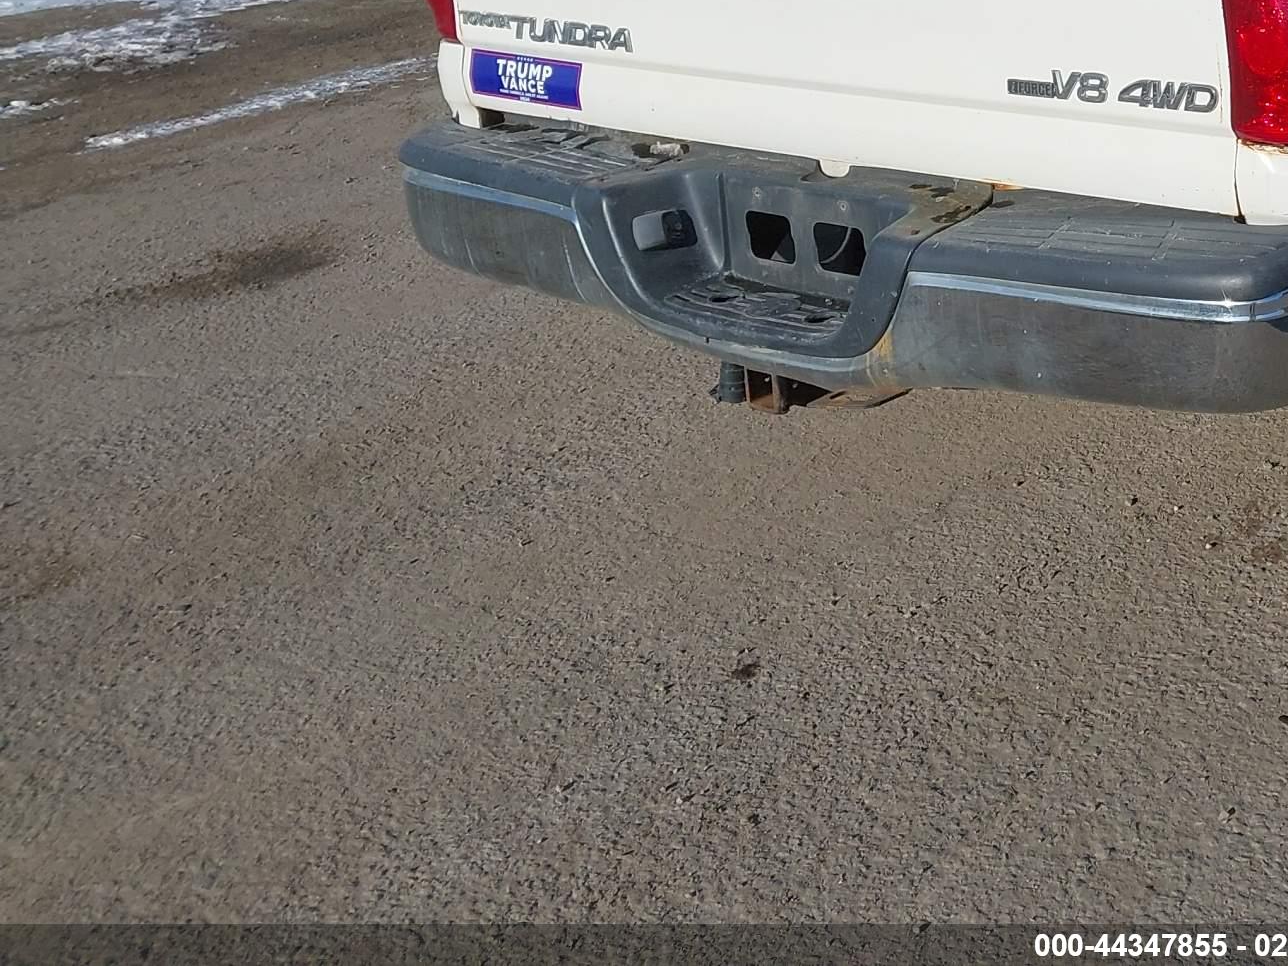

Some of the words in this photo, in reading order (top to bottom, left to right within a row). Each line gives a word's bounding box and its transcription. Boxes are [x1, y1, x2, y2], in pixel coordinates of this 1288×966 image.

[508, 16, 633, 53] TUNDRA
[496, 58, 553, 82] TRUMP
[501, 75, 545, 95] VANCE
[1051, 69, 1110, 104] V8
[1117, 79, 1220, 113] 4WD
